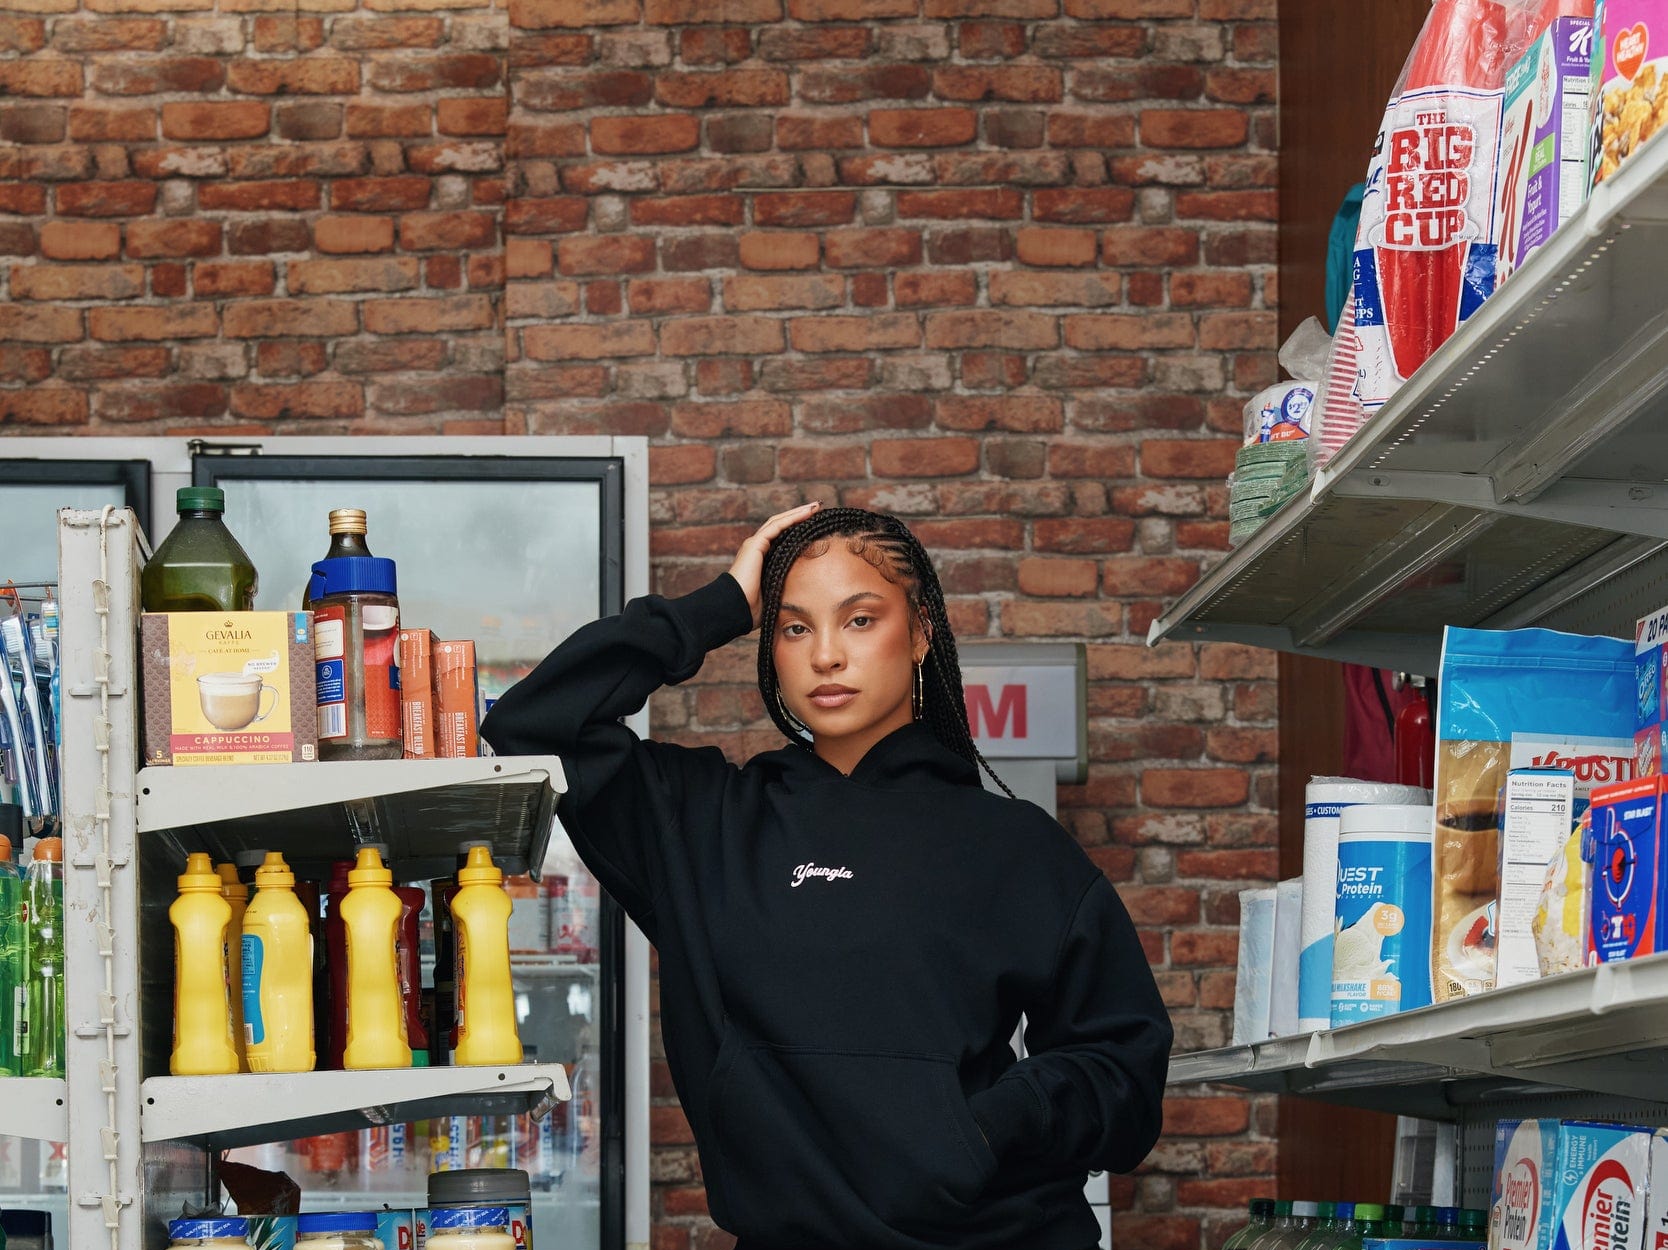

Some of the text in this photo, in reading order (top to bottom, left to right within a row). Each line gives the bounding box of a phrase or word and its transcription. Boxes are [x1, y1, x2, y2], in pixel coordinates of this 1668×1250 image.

[1416, 112, 1446, 126] THE
[1387, 126, 1473, 174] BIG
[1387, 171, 1468, 212] RED
[1385, 209, 1465, 246] CUP
[205, 629, 252, 640] GEVALIA
[1638, 665, 1656, 700] OREO
[412, 701, 422, 734] BREAKFAST
[455, 712, 465, 744] BREAKFAST
[969, 684, 1028, 739] M
[156, 750, 163, 758] 5
[194, 735, 271, 744] CAPPUCCINO
[1551, 804, 1566, 812] 210
[791, 862, 854, 888] Youngla
[1342, 882, 1383, 895] Protein
[1381, 910, 1398, 922] 3g
[1569, 1135, 1578, 1168] ENERGY
[1578, 1135, 1587, 1170] IMMUNE
[1505, 1172, 1532, 1209] Premier
[1503, 1205, 1526, 1242] Protein
